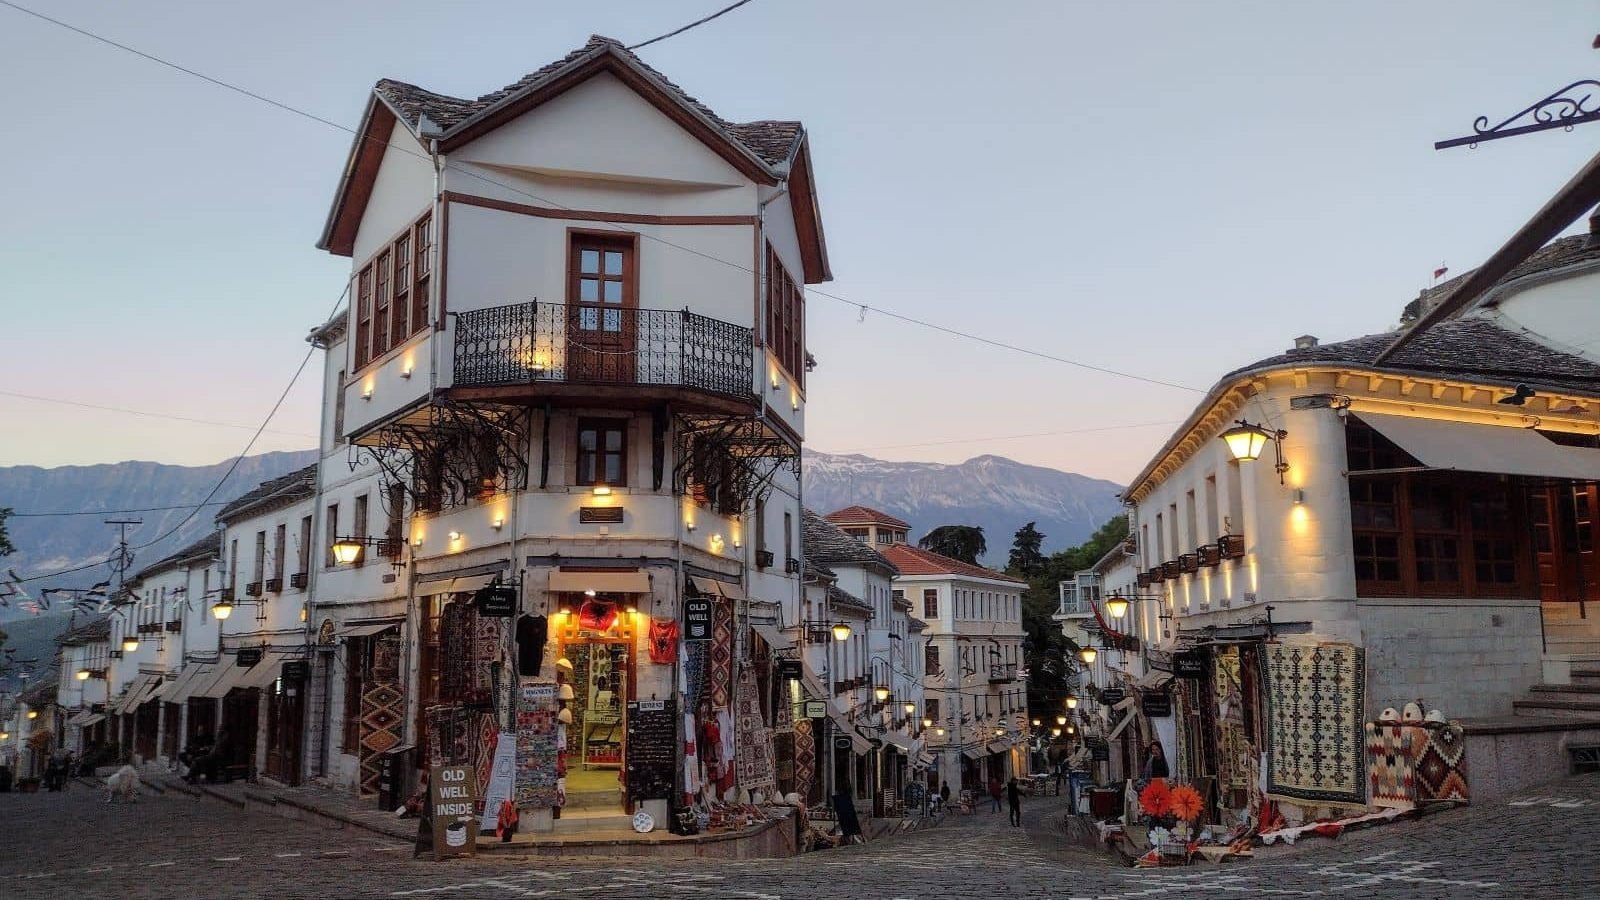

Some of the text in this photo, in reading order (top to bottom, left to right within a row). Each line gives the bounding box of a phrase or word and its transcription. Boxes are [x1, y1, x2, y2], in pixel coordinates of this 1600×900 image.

[689, 603, 708, 611] OLD
[688, 613, 708, 621] WELL
[442, 770, 465, 782] OLD
[439, 786, 469, 799] WELL
[437, 803, 473, 816] INSIDE
